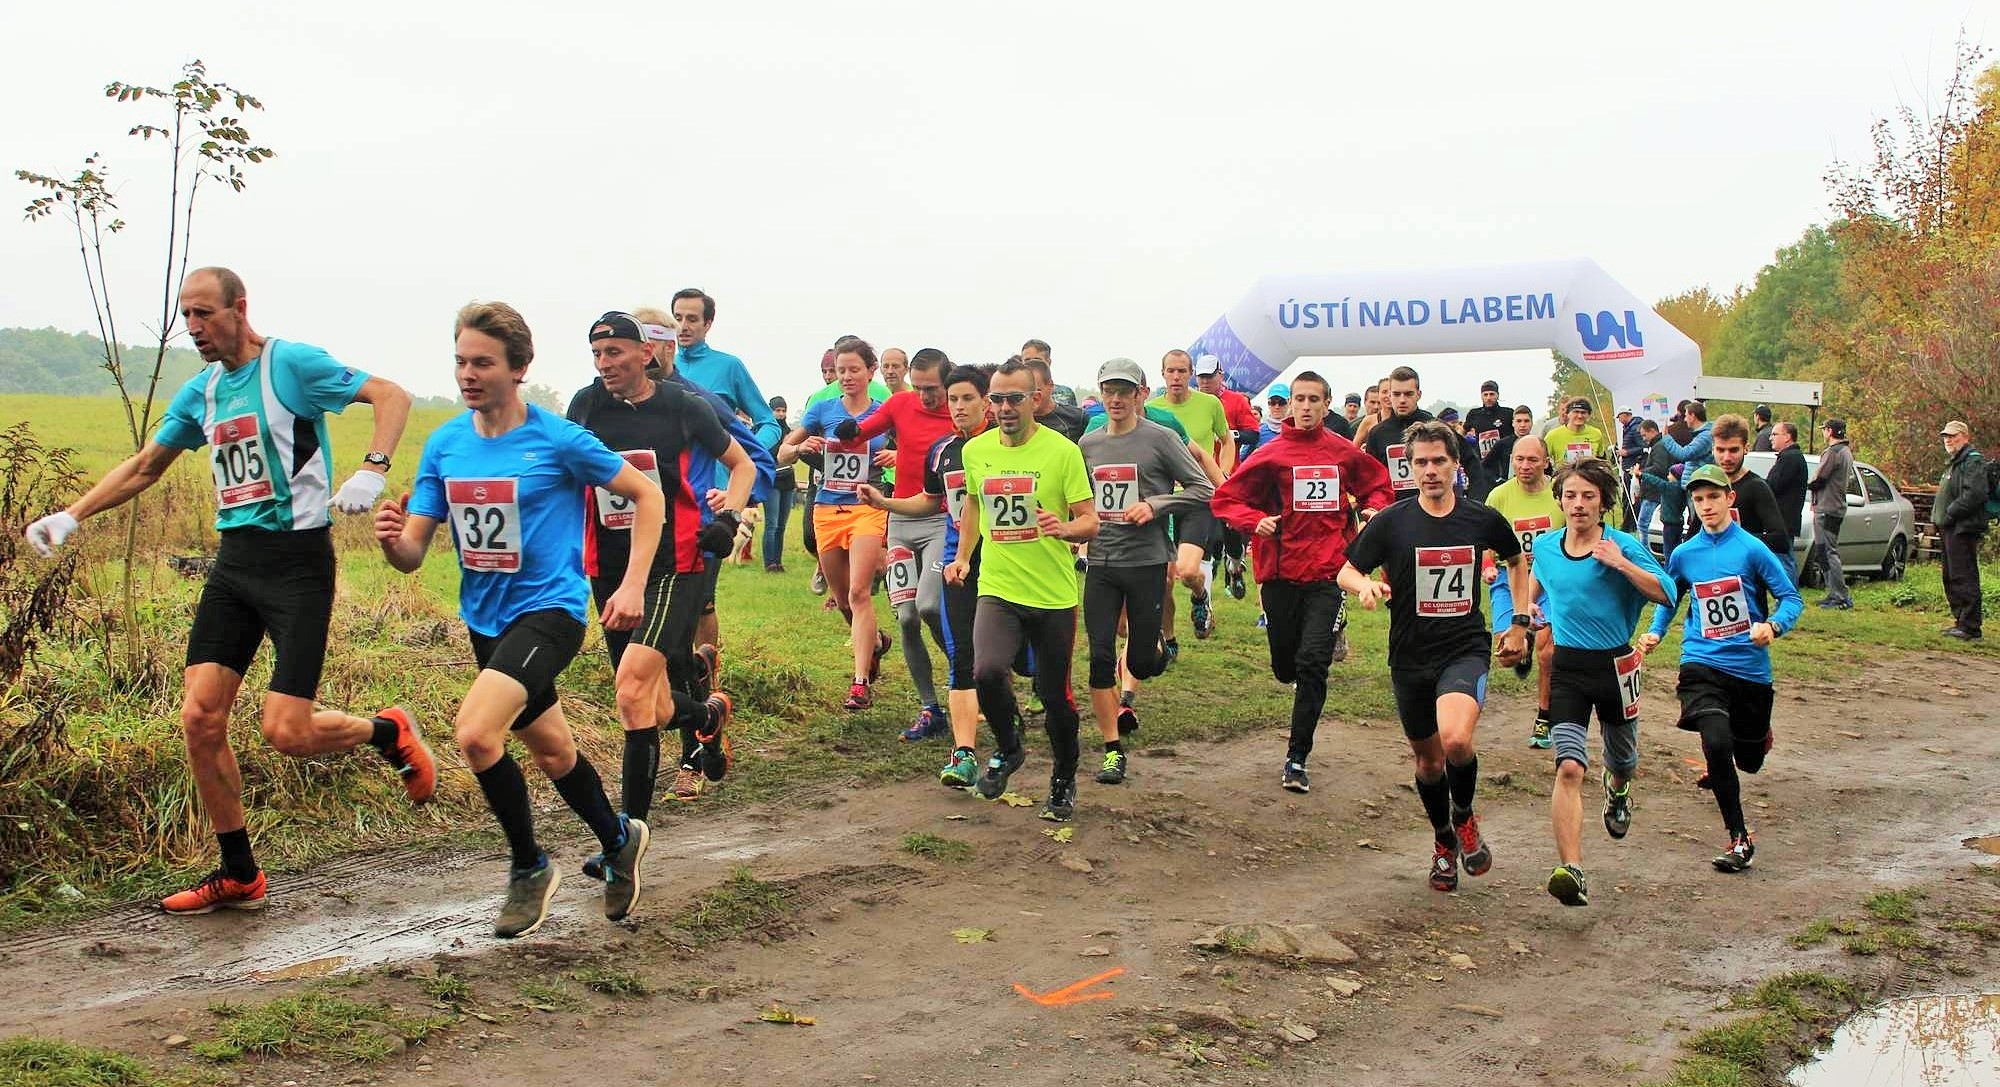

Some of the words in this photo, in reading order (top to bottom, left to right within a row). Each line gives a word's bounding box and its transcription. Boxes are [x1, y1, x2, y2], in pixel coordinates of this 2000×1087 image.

[1279, 297, 1349, 329] ÚSTÍ
[1359, 300, 1430, 326] NAD
[1440, 293, 1555, 325] LABEM
[215, 440, 264, 486] 105
[832, 454, 861, 479] 29
[1102, 482, 1129, 510] 87
[1306, 481, 1327, 500] 23
[993, 495, 1028, 526] 25
[464, 507, 507, 549] 32
[1429, 568, 1465, 599] 74
[1706, 595, 1740, 626] 86
